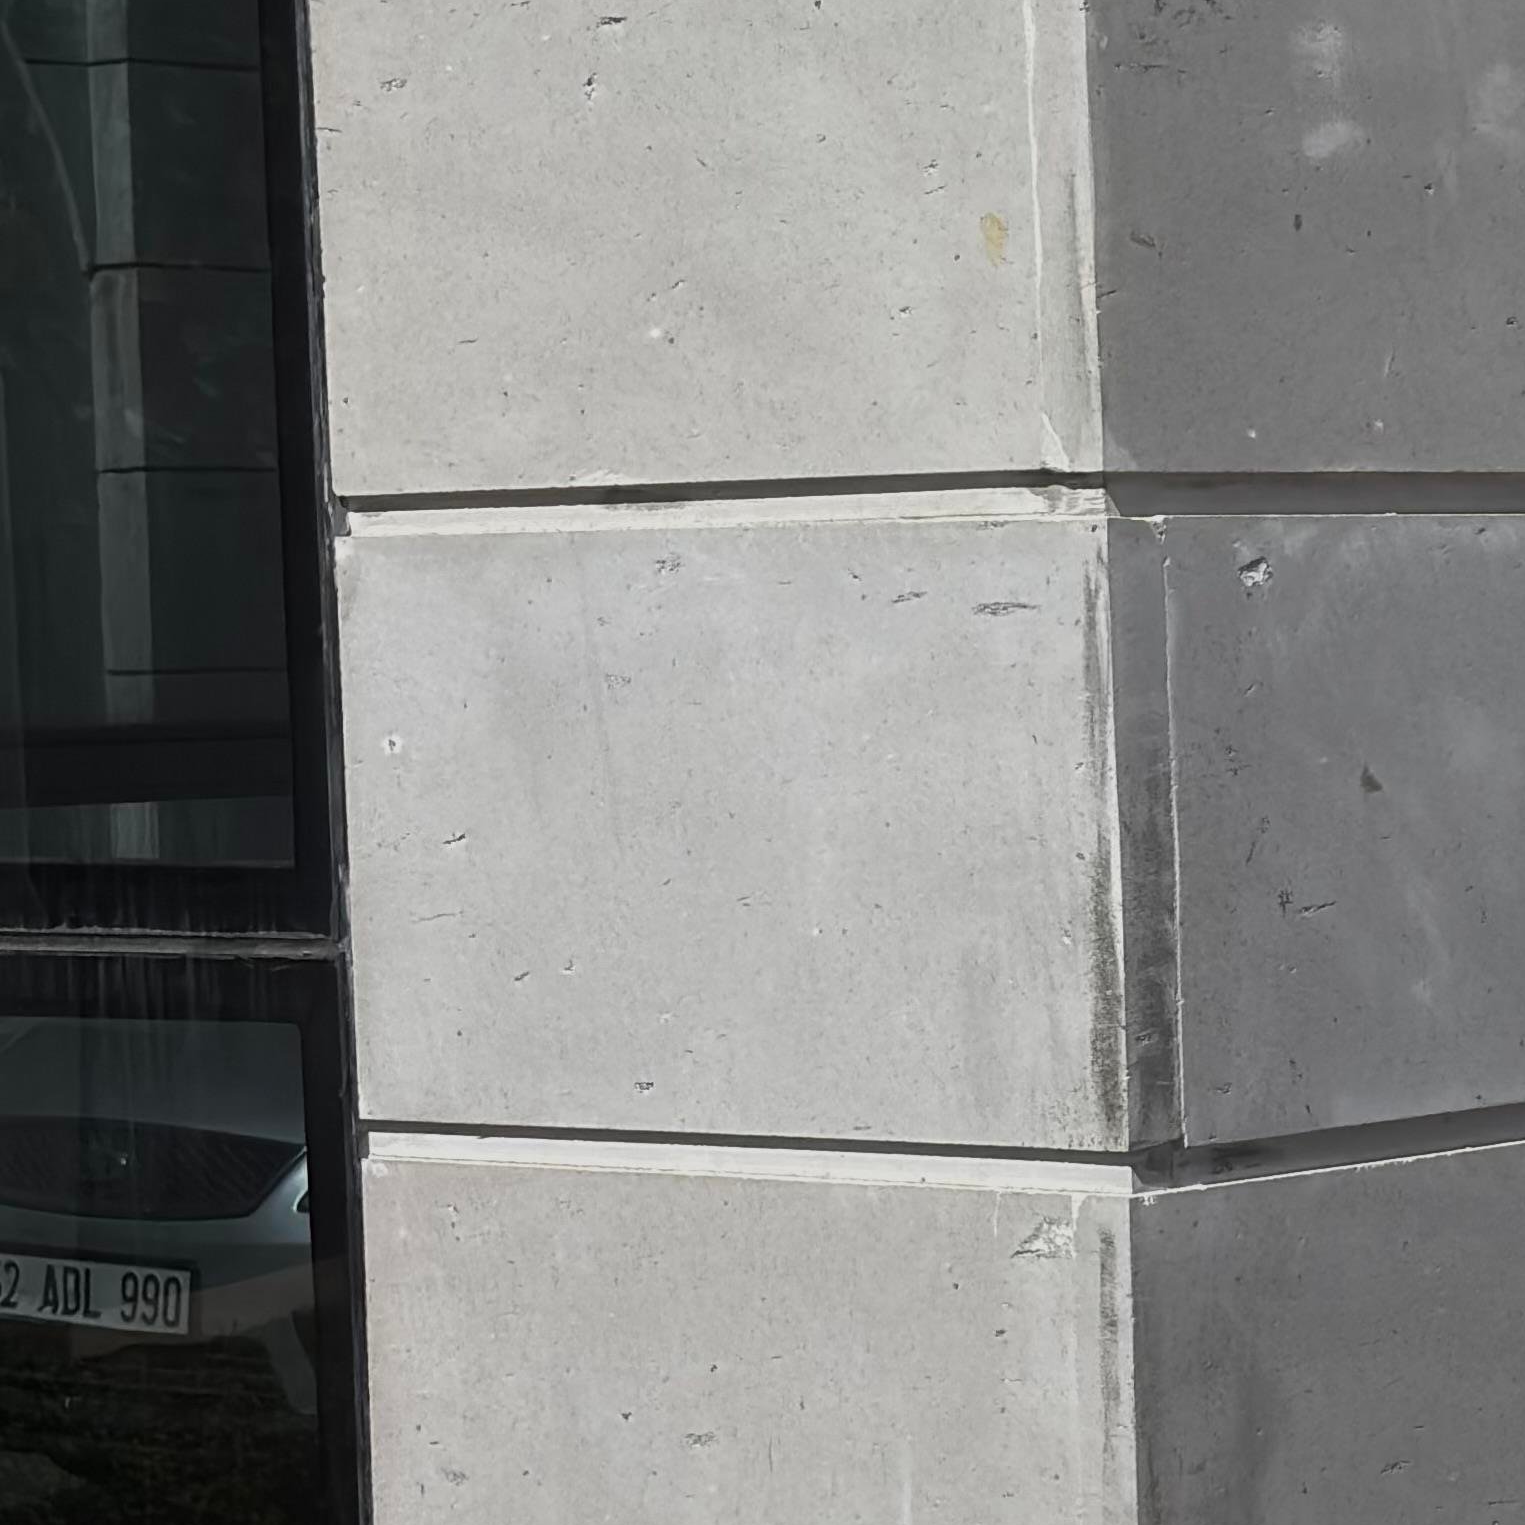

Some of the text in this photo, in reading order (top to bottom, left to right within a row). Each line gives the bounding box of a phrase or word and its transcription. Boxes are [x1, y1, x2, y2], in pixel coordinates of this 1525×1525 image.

[0, 1260, 183, 1328] 2 ADL 990
